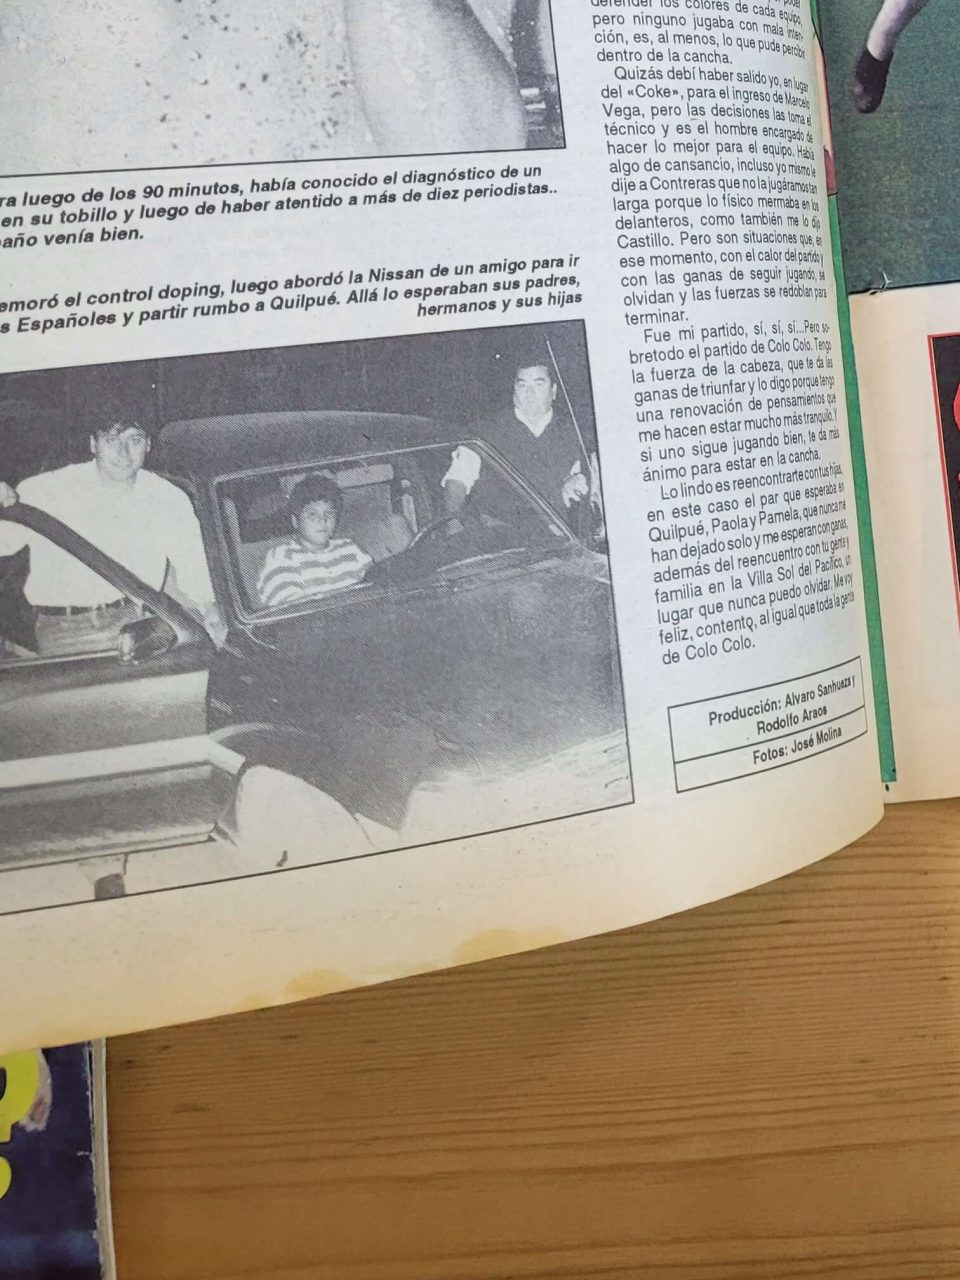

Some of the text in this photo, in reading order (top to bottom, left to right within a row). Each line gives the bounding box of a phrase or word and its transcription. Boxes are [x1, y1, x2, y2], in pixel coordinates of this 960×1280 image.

[596, 47, 733, 65] dentro de la cancha.
[22, 191, 76, 209] luego
[81, 187, 105, 203] de
[109, 186, 137, 202] los
[142, 184, 165, 199] 90
[168, 181, 244, 198] minutos,
[249, 176, 296, 194] había
[301, 172, 378, 190] conocido
[382, 170, 398, 185] el
[401, 166, 496, 187] diagnóstico
[500, 164, 519, 179] de
[523, 166, 542, 178] un
[0, 182, 558, 228] en su tobillo y luego de haber atentido a más de diez periodistas..
[0, 226, 144, 249] año venía bien.
[616, 229, 798, 250] Castillo. Pero son situaciones
[64, 291, 82, 308] el
[86, 285, 154, 306] control
[157, 282, 225, 302] doping,
[230, 279, 279, 296] luego
[283, 270, 344, 290] abordó
[348, 269, 364, 285] la
[368, 267, 425, 283] Nissan
[429, 263, 450, 278] de
[454, 264, 474, 276] un
[478, 258, 527, 275] amigo
[531, 257, 565, 274] para
[568, 253, 581, 268] ir
[16, 311, 117, 335] Españoles
[122, 311, 135, 328] y
[138, 303, 189, 326] partir
[192, 299, 251, 318] rumbo
[254, 300, 265, 312] a
[270, 291, 341, 312] Quilpué.
[345, 287, 378, 305] Allá
[383, 286, 399, 302] lo
[403, 280, 488, 302] esperaban
[492, 279, 521, 292] sus
[524, 273, 580, 293] padres,
[417, 290, 583, 318] hermanos y sus hijas
[624, 308, 689, 326] terminar.
[643, 319, 784, 344] Fue mi partido, sí, sí,
[662, 634, 756, 666] de Colo Colo.
[708, 698, 782, 726] Producción:
[784, 689, 816, 708] Alvaro
[756, 705, 828, 736] Rodolfo Araos
[752, 726, 842, 765] Fotos: José Molina
